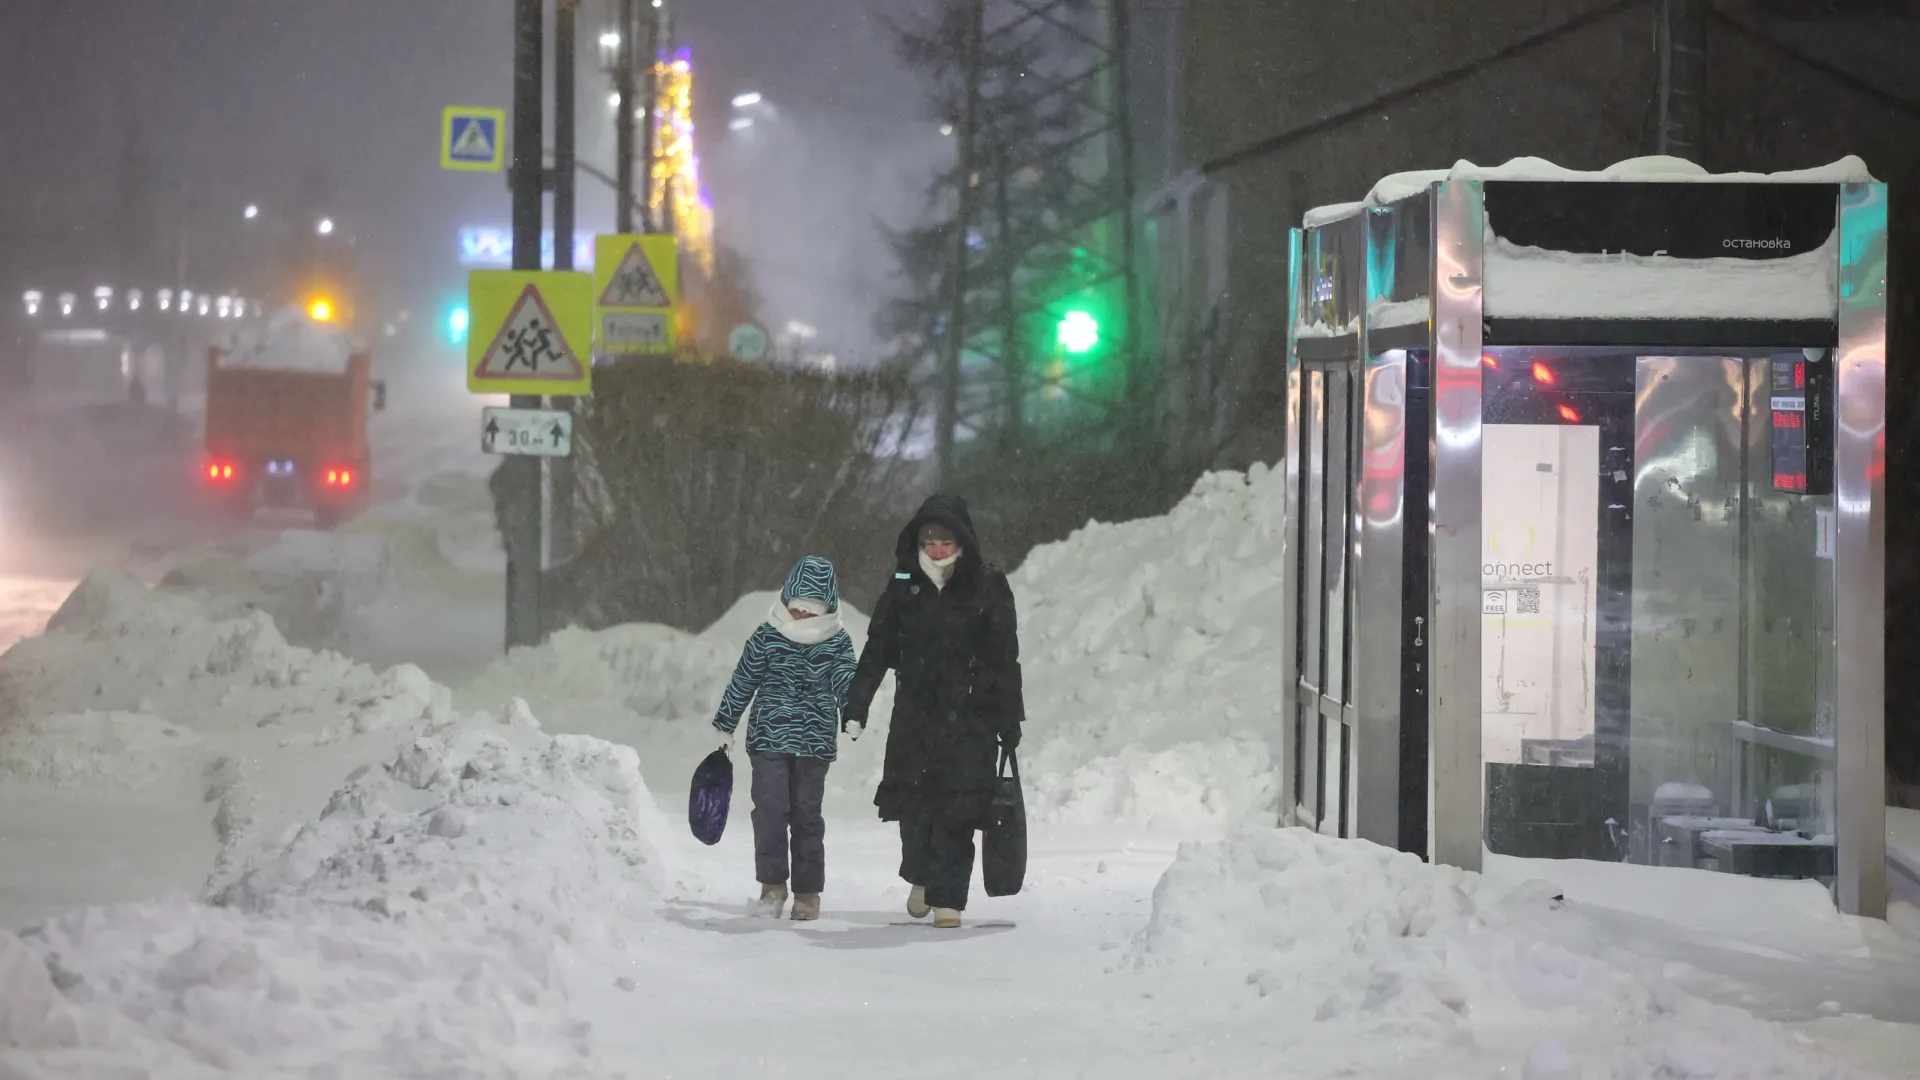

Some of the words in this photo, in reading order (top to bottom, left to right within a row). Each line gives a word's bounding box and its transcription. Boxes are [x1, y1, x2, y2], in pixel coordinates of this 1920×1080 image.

[1722, 237, 1791, 249] остановка
[508, 430, 529, 446] 30
[1482, 561, 1553, 576] onnect
[1486, 604, 1505, 612] FREE
